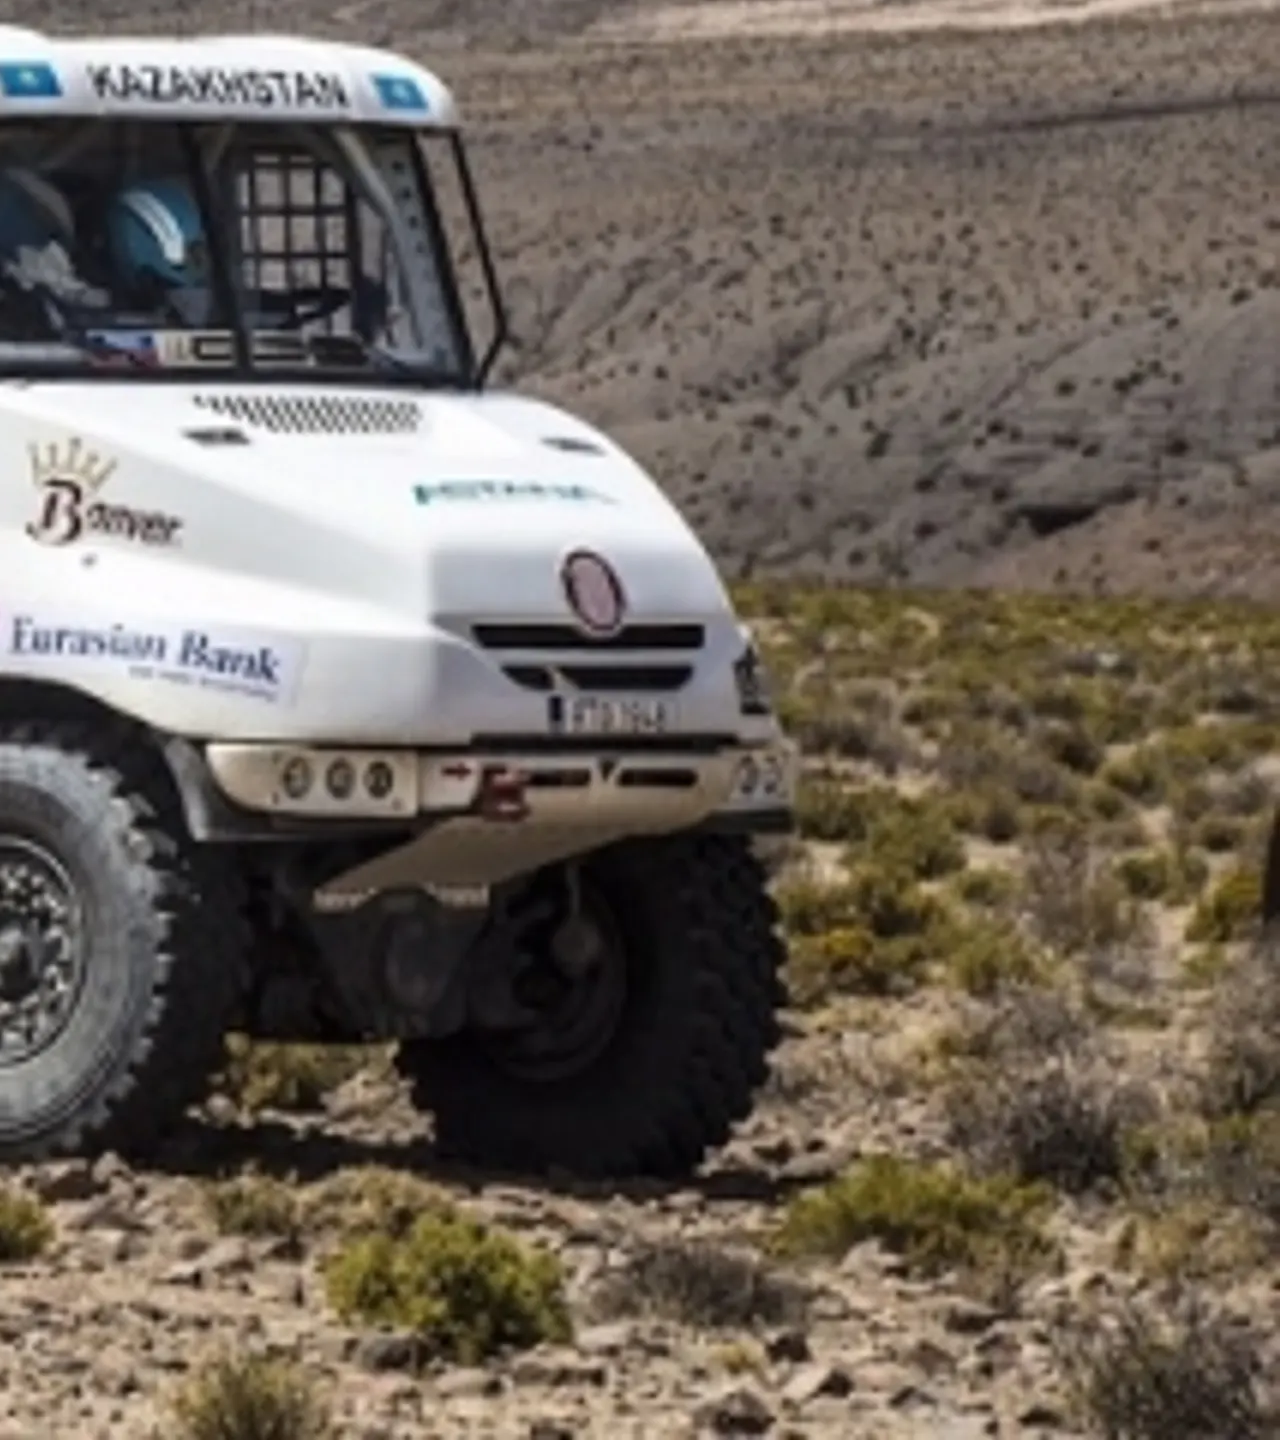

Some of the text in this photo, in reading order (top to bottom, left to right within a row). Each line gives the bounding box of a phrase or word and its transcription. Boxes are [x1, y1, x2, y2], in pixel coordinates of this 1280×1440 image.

[87, 65, 350, 108] KAZAKHSTAN
[9, 616, 166, 660] Eurasian
[178, 629, 280, 685] Bank
